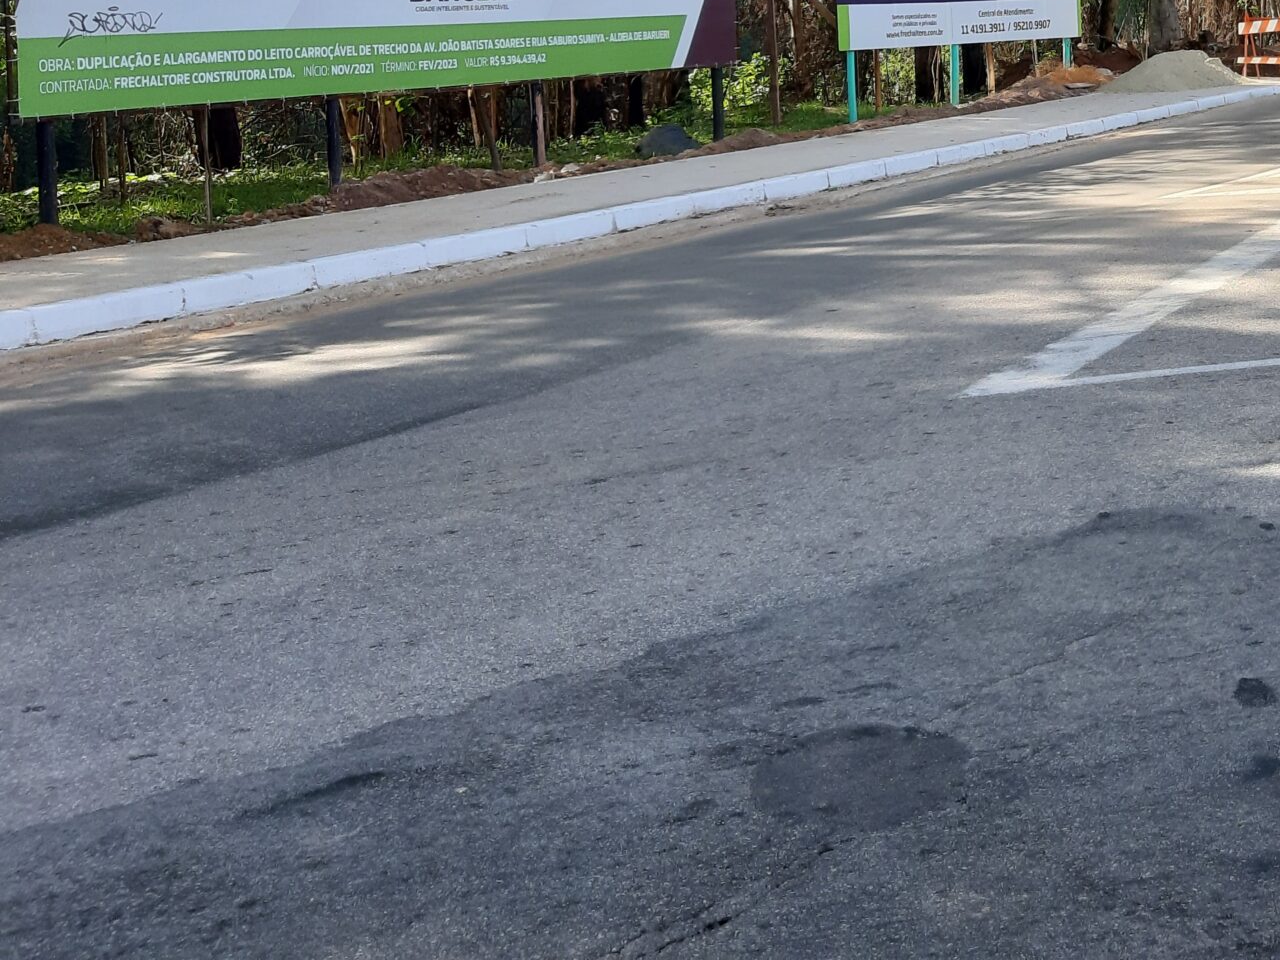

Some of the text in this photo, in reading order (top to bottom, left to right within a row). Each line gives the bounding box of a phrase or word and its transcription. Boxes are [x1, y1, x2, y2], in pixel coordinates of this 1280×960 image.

[415, 5, 436, 13] CIDADE
[436, 4, 470, 12] INTELIGENTE
[475, 3, 510, 11] SUSTENTÁVEL
[978, 9, 996, 18] Central
[1013, 20, 1051, 31] 95210.9907
[38, 57, 75, 73] OBRA:
[77, 51, 151, 71] DUPLICAÇÃO
[153, 53, 161, 66] E
[162, 48, 246, 66] ALARGAMENTO
[247, 48, 263, 61] DO
[264, 47, 294, 60] LEITO
[294, 42, 358, 61] CARROÇÁVEL
[359, 44, 373, 56] DE
[372, 43, 408, 55] TRECHO
[410, 42, 422, 54] DA
[423, 41, 437, 53] AV.
[438, 38, 460, 53] JOÃO
[460, 39, 494, 51] BATISTA
[495, 38, 526, 49] SOARES
[526, 37, 531, 47] E
[531, 36, 547, 47] RUA
[548, 34, 578, 46] SABURO
[578, 33, 606, 44] SUMIYA
[609, 32, 633, 42] ALDEIA
[633, 31, 643, 41] DE
[643, 30, 670, 40] BARUERI
[39, 78, 112, 94] CONTRATADA:
[114, 73, 191, 89] FRECHALTORE
[191, 68, 268, 84] CONSTRUTORA
[268, 67, 296, 80] LTDA.
[303, 63, 330, 77] INÍCIO:
[331, 62, 375, 76] NOV/2021
[381, 57, 418, 73] TÉRMINO:
[418, 58, 458, 71] FEV/2023
[464, 56, 489, 68] VALOR:
[489, 55, 500, 67] R$
